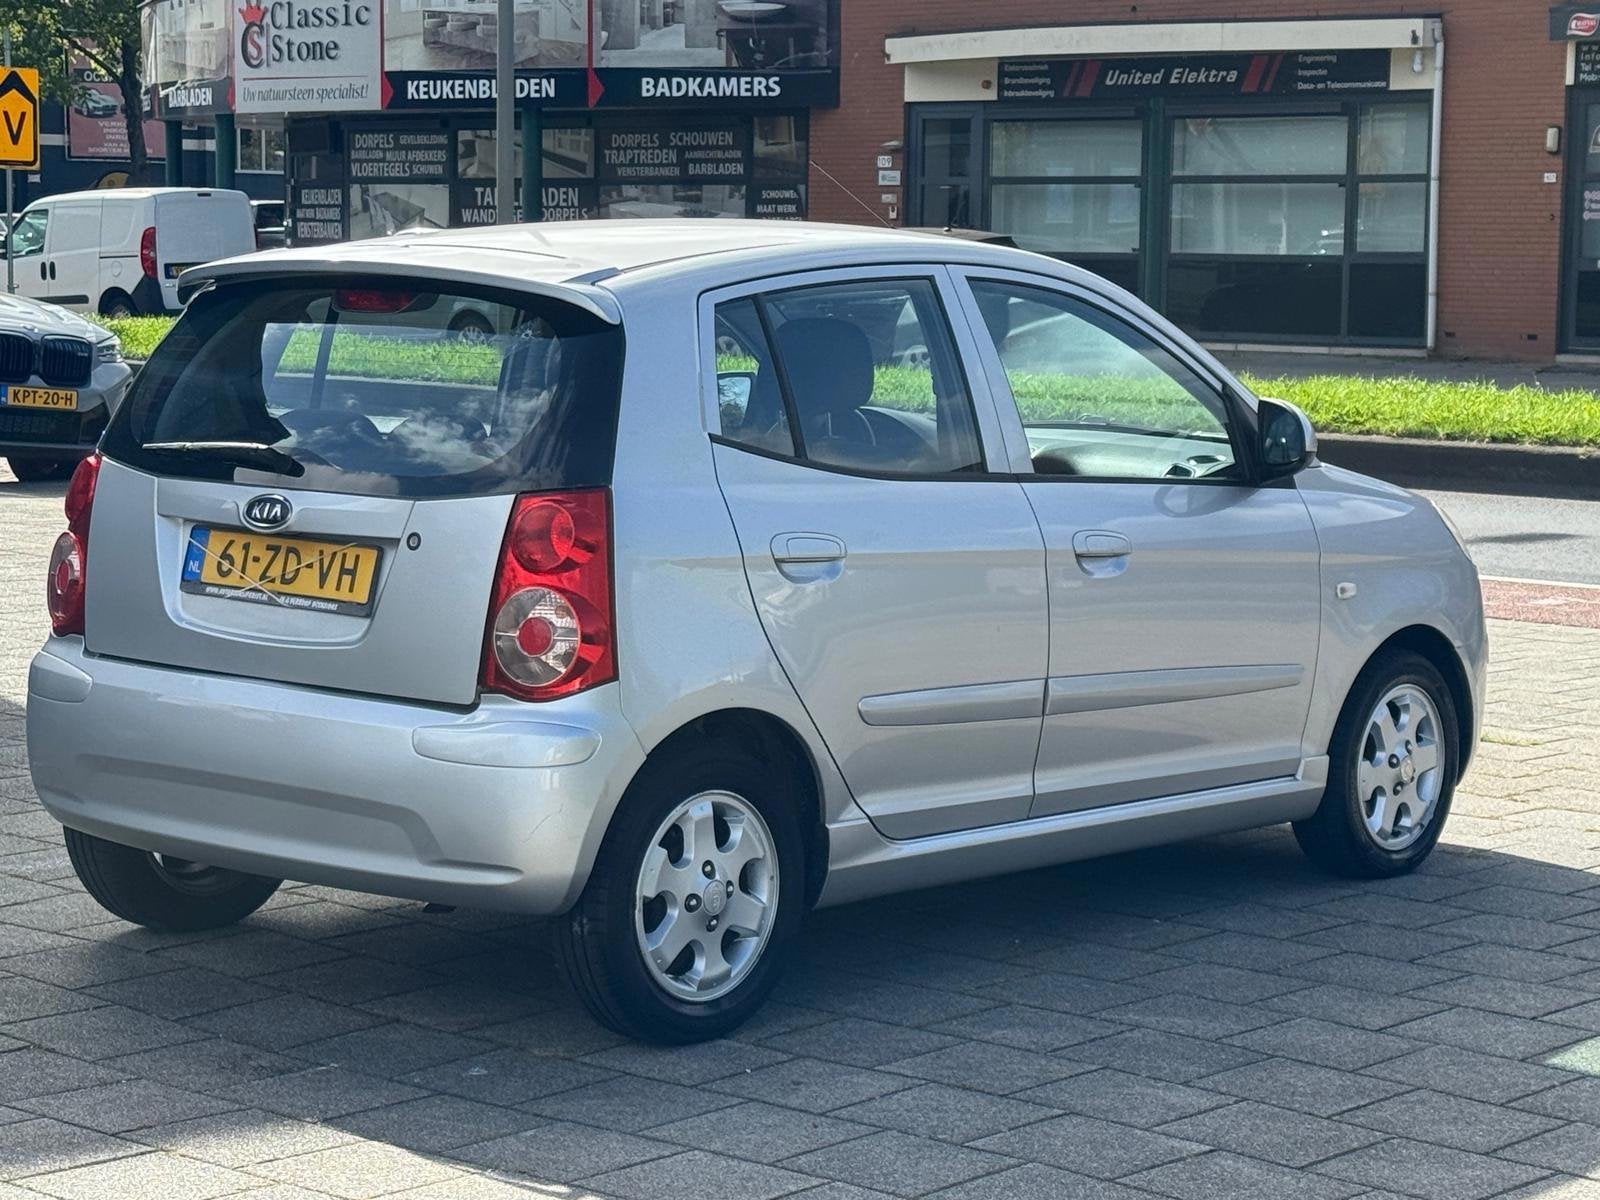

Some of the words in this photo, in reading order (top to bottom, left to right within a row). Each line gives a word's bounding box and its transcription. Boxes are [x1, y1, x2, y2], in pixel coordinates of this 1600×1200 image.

[271, 0, 370, 29] Classic
[272, 34, 340, 62] Stone
[1105, 69, 1164, 86] United
[1169, 67, 1238, 84] Elektra
[243, 87, 256, 102] Uw
[257, 85, 315, 101] natuursteen
[317, 83, 369, 102] specialist!
[407, 78, 556, 100] KEUKENBLDEN
[641, 76, 782, 97] BADKAMERS
[3, 110, 27, 145] V
[355, 134, 394, 149] DORPELS
[611, 133, 660, 148] DORPELS
[669, 131, 733, 146] SCHOUWEN
[386, 150, 406, 161] MUUR
[407, 149, 447, 162] AFDEKKERS
[604, 149, 677, 164] TRAPTREDEN
[351, 162, 410, 177] VLOERTEGELS
[617, 166, 681, 177] VENSTERBANKEN
[688, 163, 744, 175] BARBLADEN
[12, 389, 73, 406] KPT-20-H
[251, 502, 283, 520] KIA
[187, 559, 201, 573] NL
[216, 539, 361, 593] 61-ZD-VH
